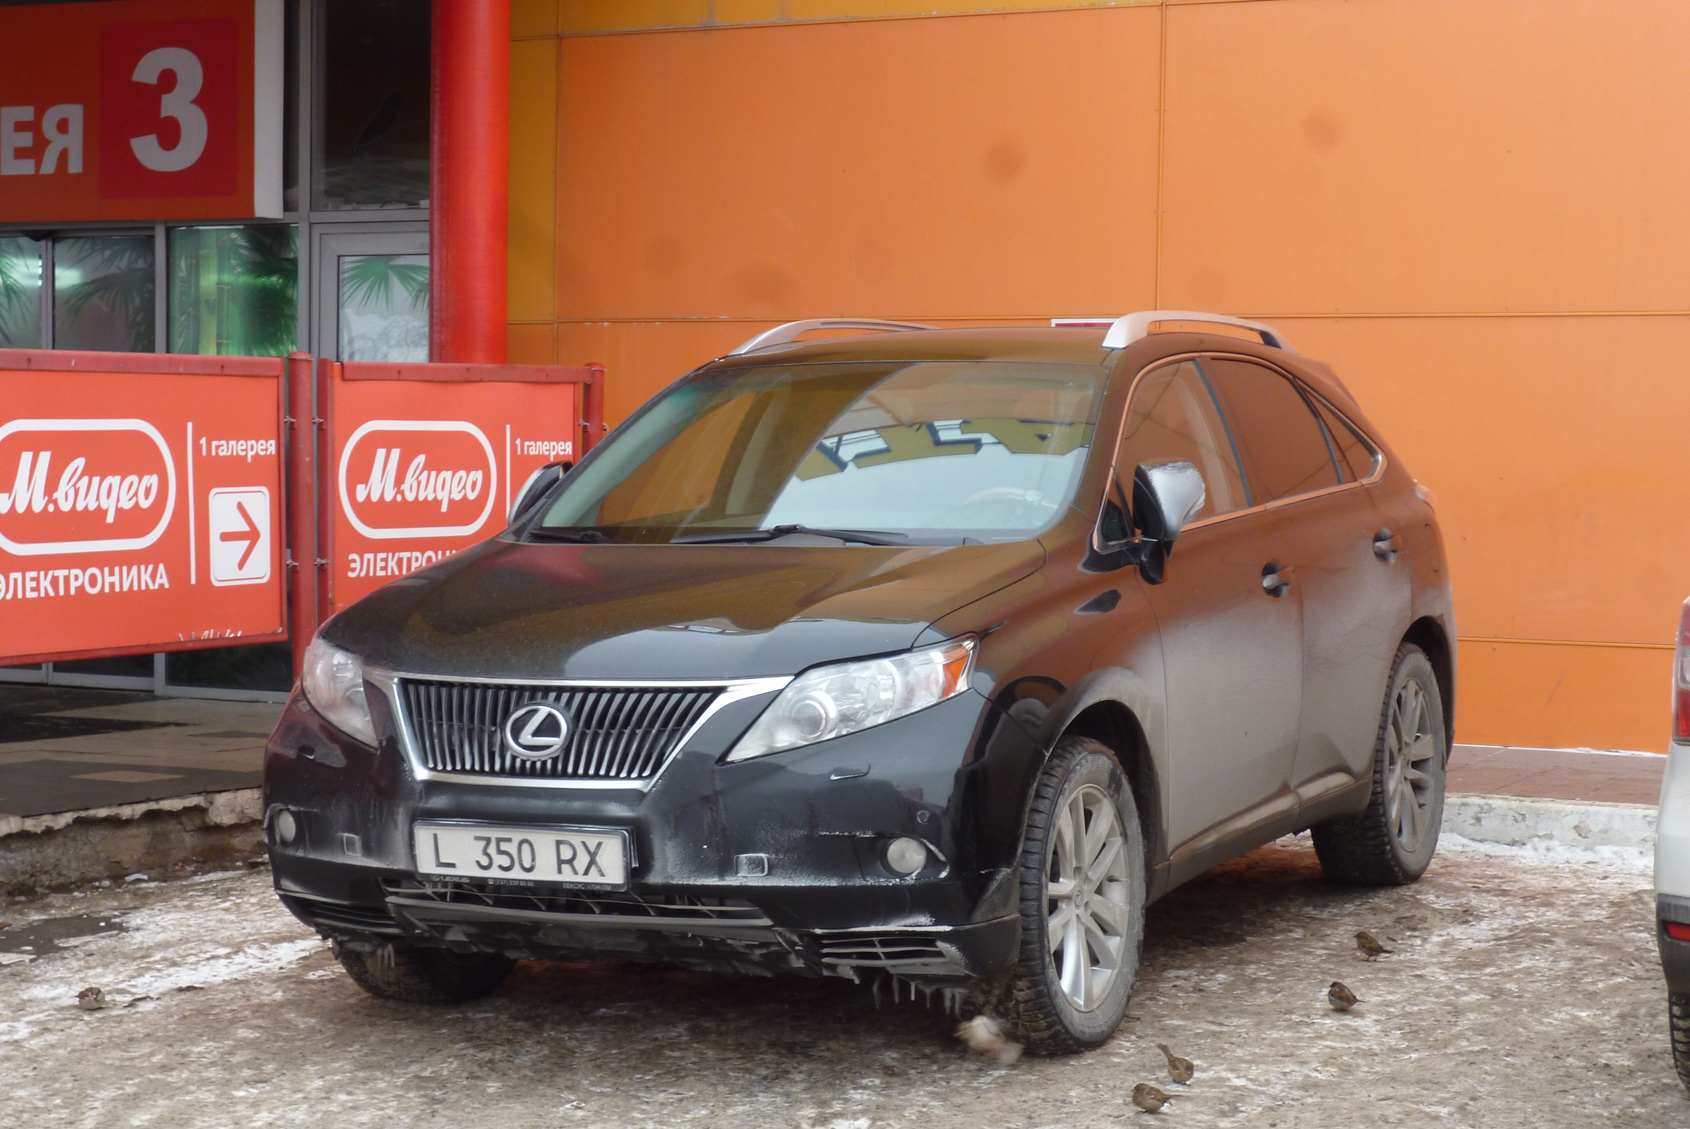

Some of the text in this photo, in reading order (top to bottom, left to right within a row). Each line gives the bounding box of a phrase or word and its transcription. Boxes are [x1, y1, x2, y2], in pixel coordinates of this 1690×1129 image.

[129, 46, 208, 172] 3
[199, 436, 276, 463] 1 галерея
[515, 437, 572, 461] 1 галерея
[432, 833, 606, 877] L 350 RX
